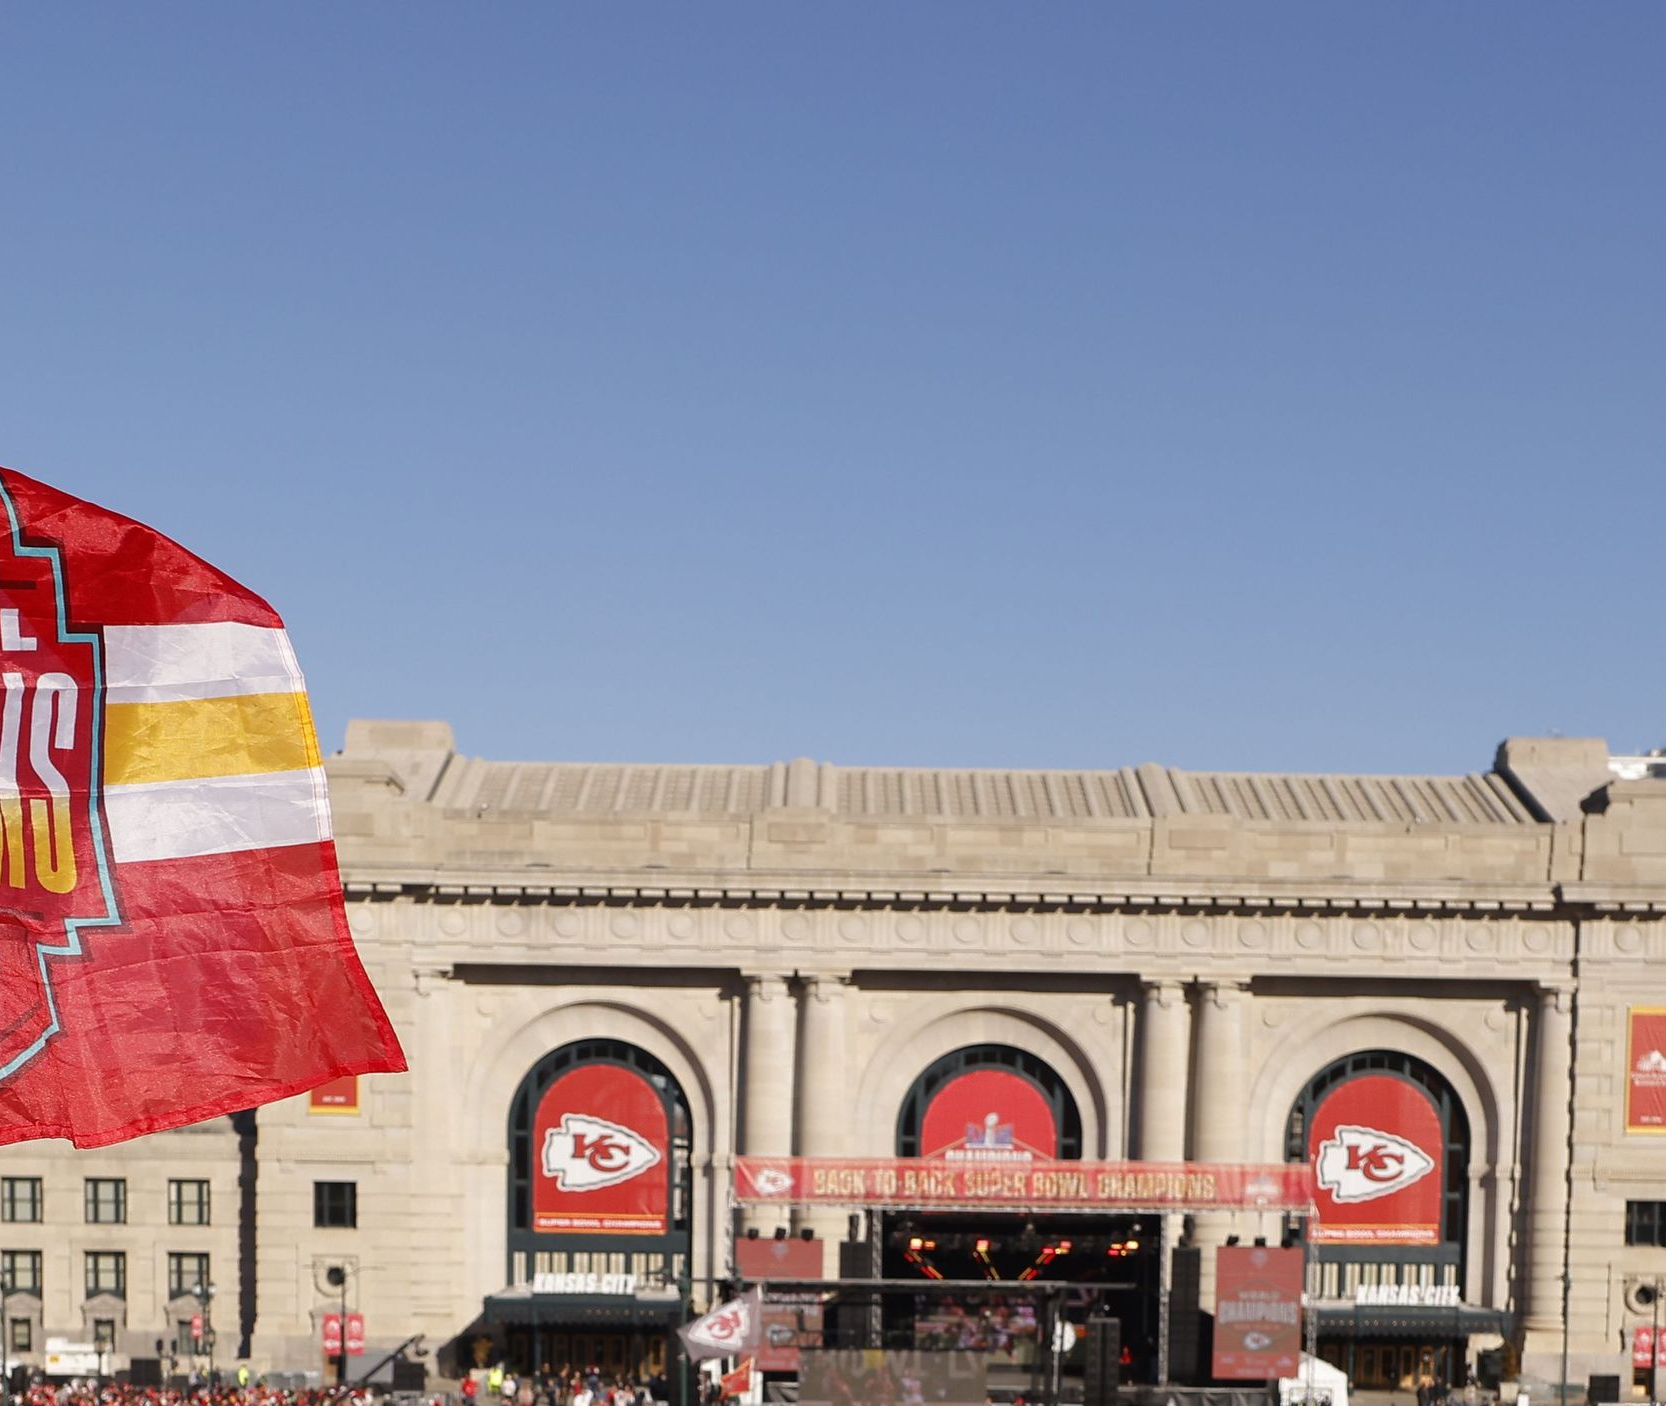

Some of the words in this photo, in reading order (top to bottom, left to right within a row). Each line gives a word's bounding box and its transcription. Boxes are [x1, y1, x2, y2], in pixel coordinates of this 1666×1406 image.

[572, 1133, 631, 1173] KC
[1345, 1144, 1406, 1183] KC
[964, 1169, 1027, 1197] SUPER
[1033, 1171, 1089, 1199] BOWL
[1097, 1173, 1216, 1200] CHAMPIONS
[533, 1272, 597, 1294] KANSAS
[601, 1273, 637, 1295] CITY
[1356, 1284, 1421, 1305] KANSAS
[1423, 1285, 1461, 1307] CITY
